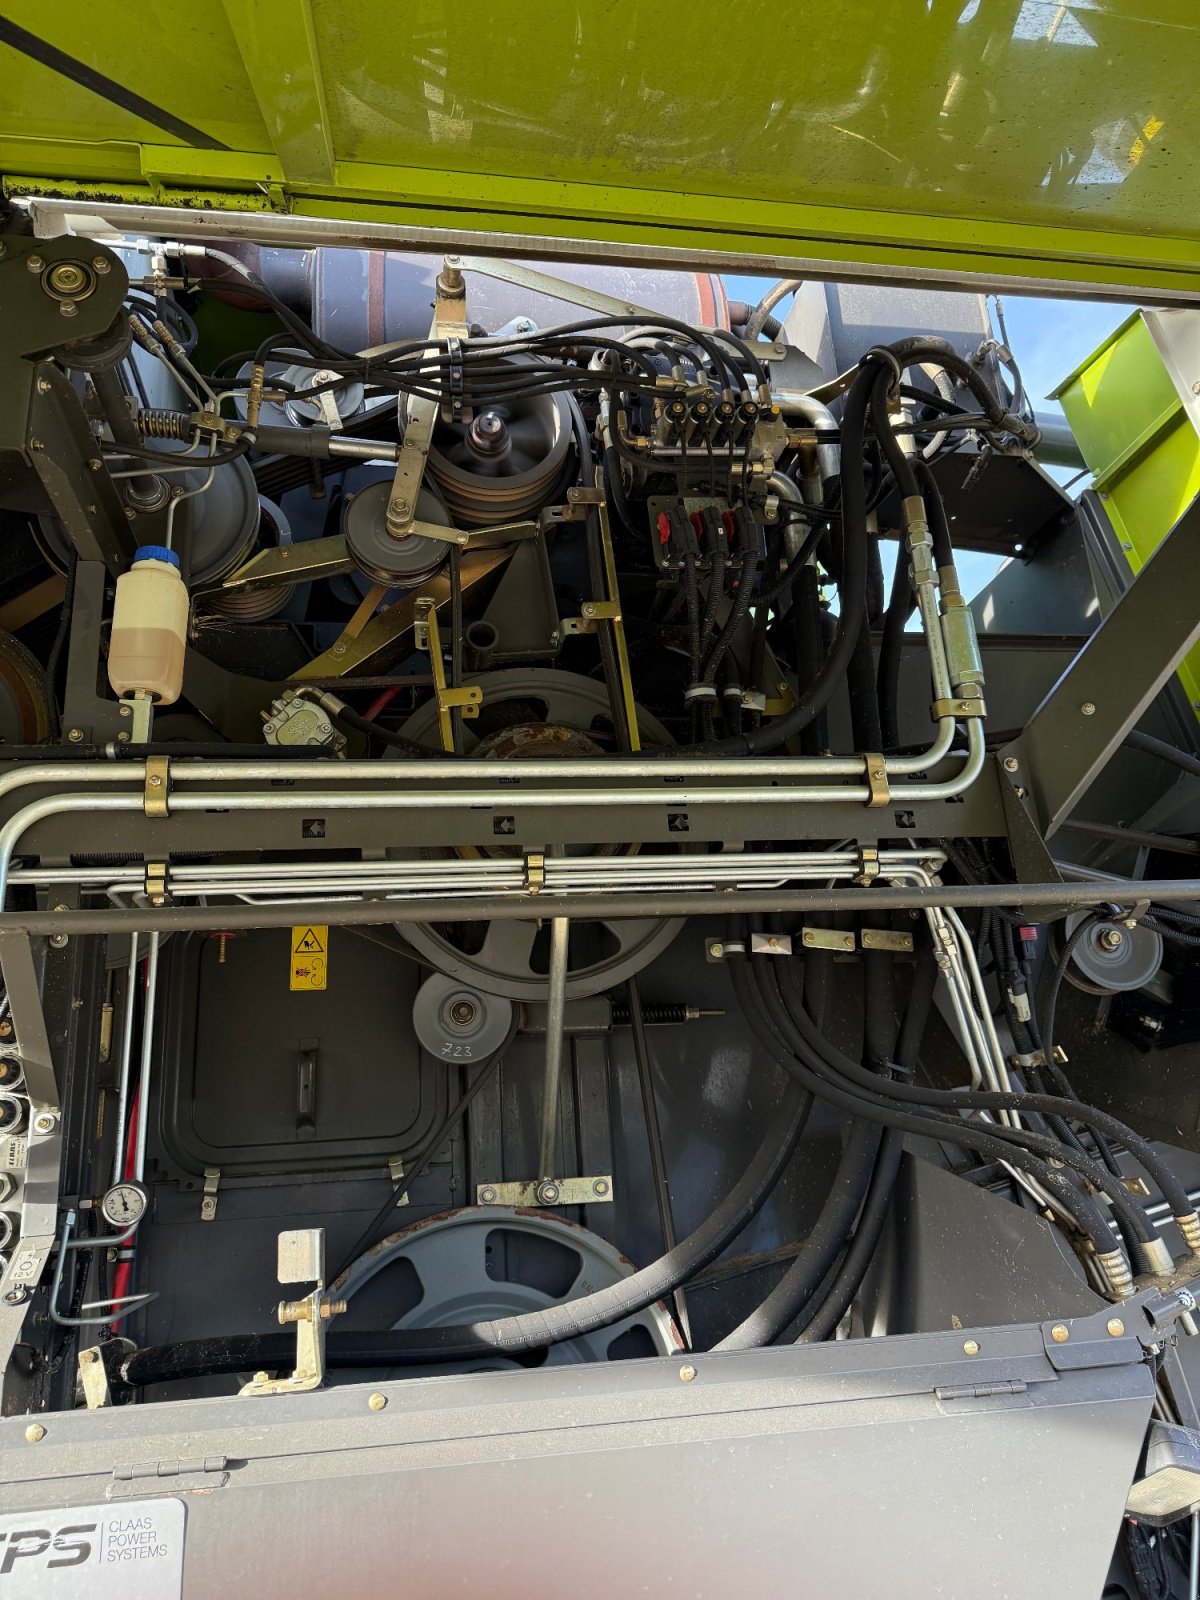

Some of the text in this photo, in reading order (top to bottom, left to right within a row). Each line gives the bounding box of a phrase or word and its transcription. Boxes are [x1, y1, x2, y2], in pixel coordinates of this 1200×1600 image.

[108, 1517, 152, 1533] CLAAS
[108, 1531, 157, 1548] POWER
[0, 1523, 98, 1574] PS
[107, 1544, 168, 1562] SYSTEMS
